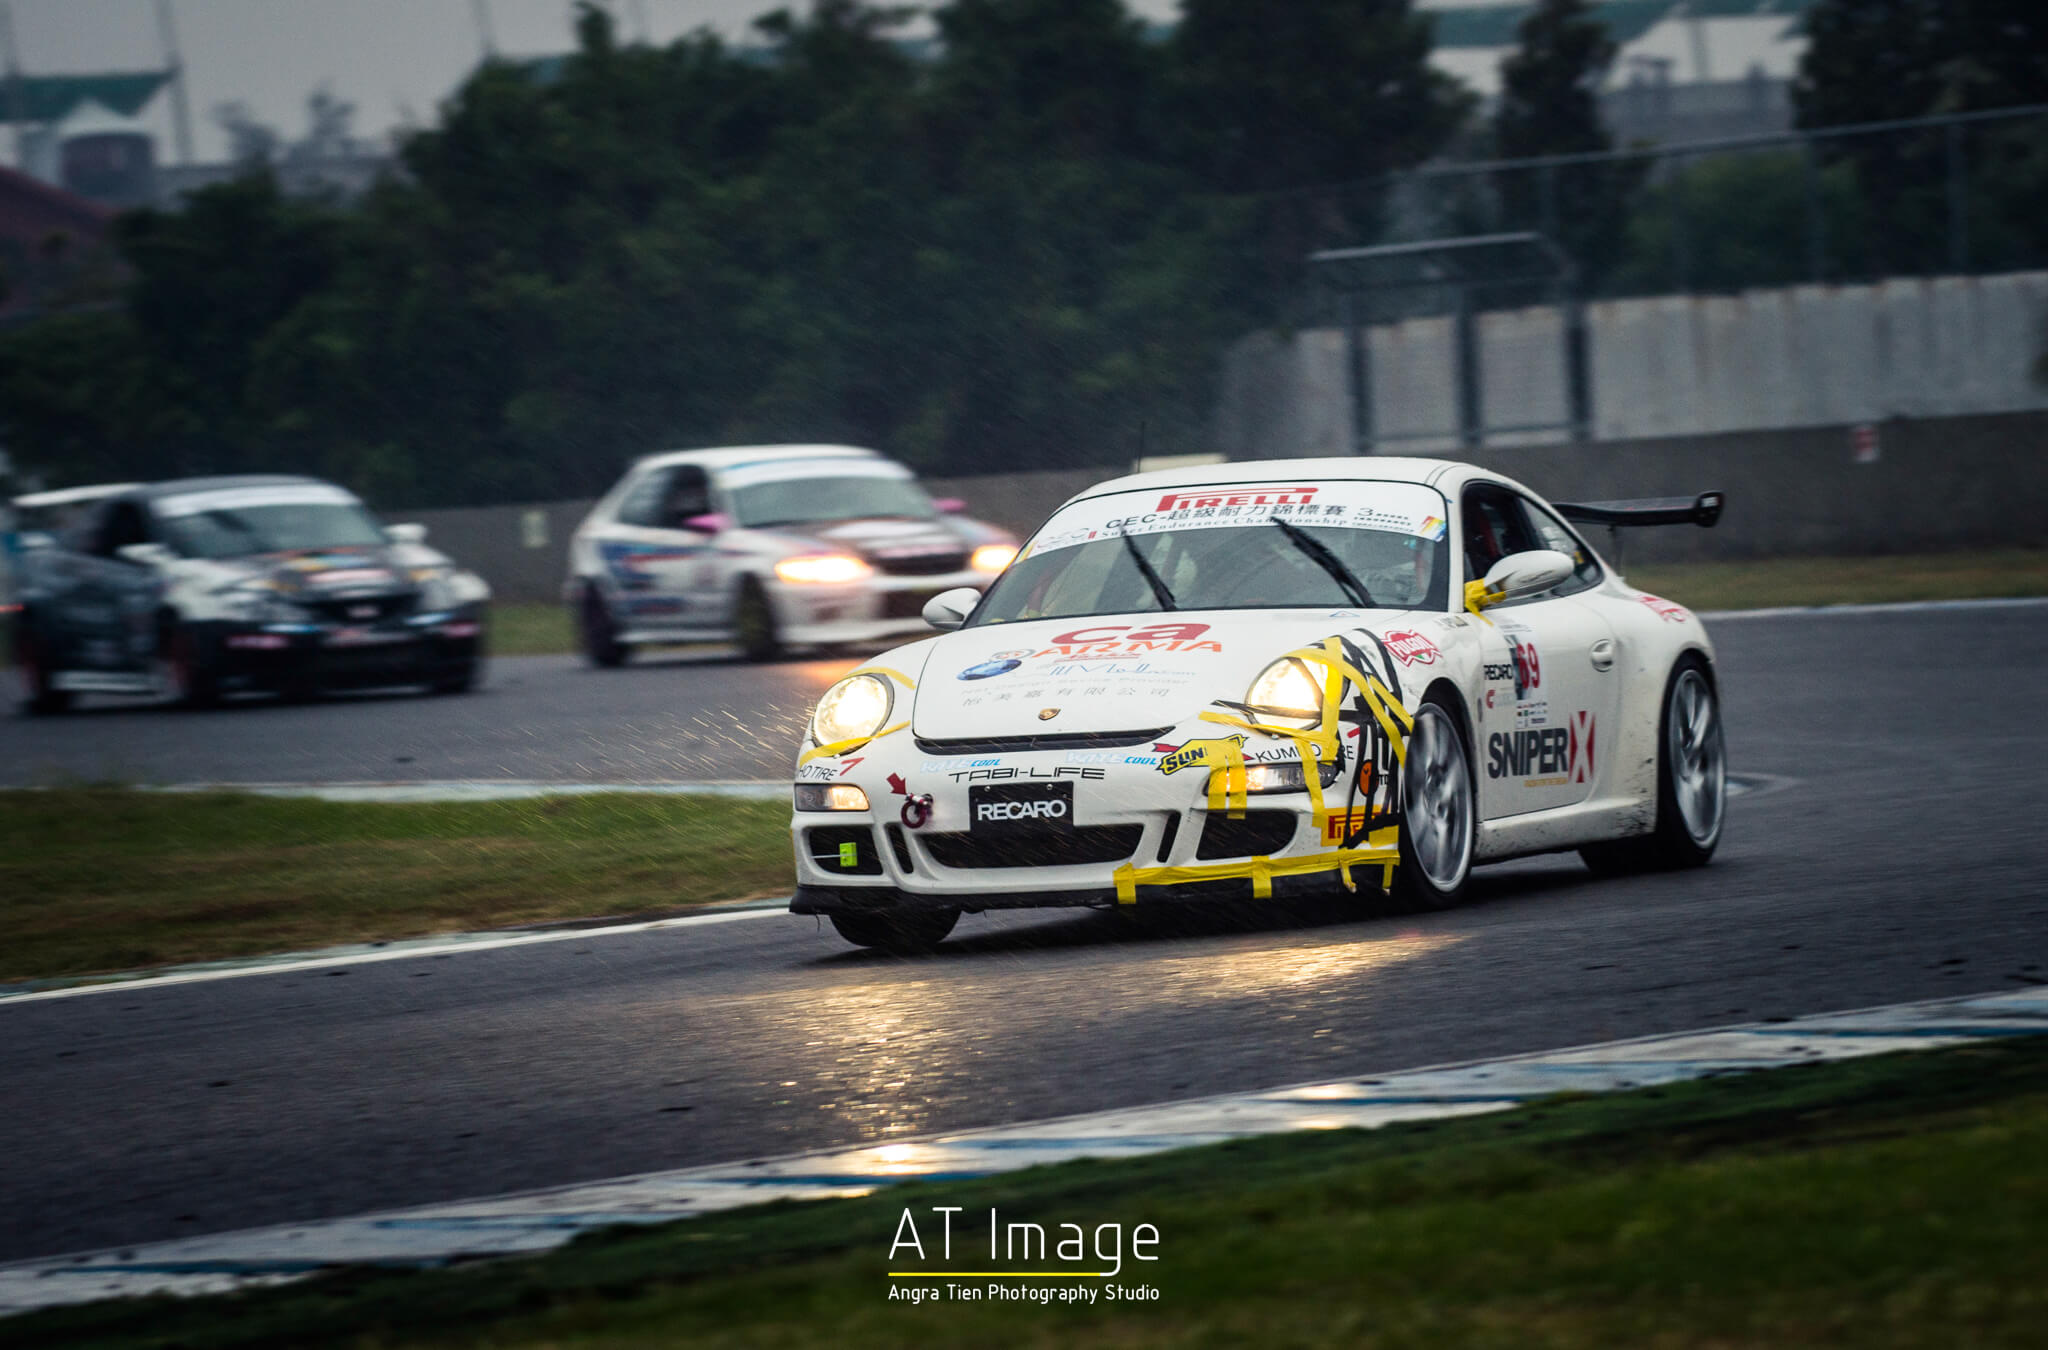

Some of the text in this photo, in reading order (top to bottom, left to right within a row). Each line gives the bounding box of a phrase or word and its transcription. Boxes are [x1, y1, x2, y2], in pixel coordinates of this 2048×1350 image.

[1156, 487, 1318, 512] PIRELLI
[1149, 517, 1229, 531] Endurance
[1233, 515, 1347, 526] Chaionship
[1031, 640, 1222, 658] ARMA
[1516, 642, 1540, 690] 69
[1256, 743, 1321, 762] KUMO
[812, 765, 838, 781] TIRE
[948, 766, 1105, 783] TABI-LIFE
[977, 799, 1067, 821] RECARO
